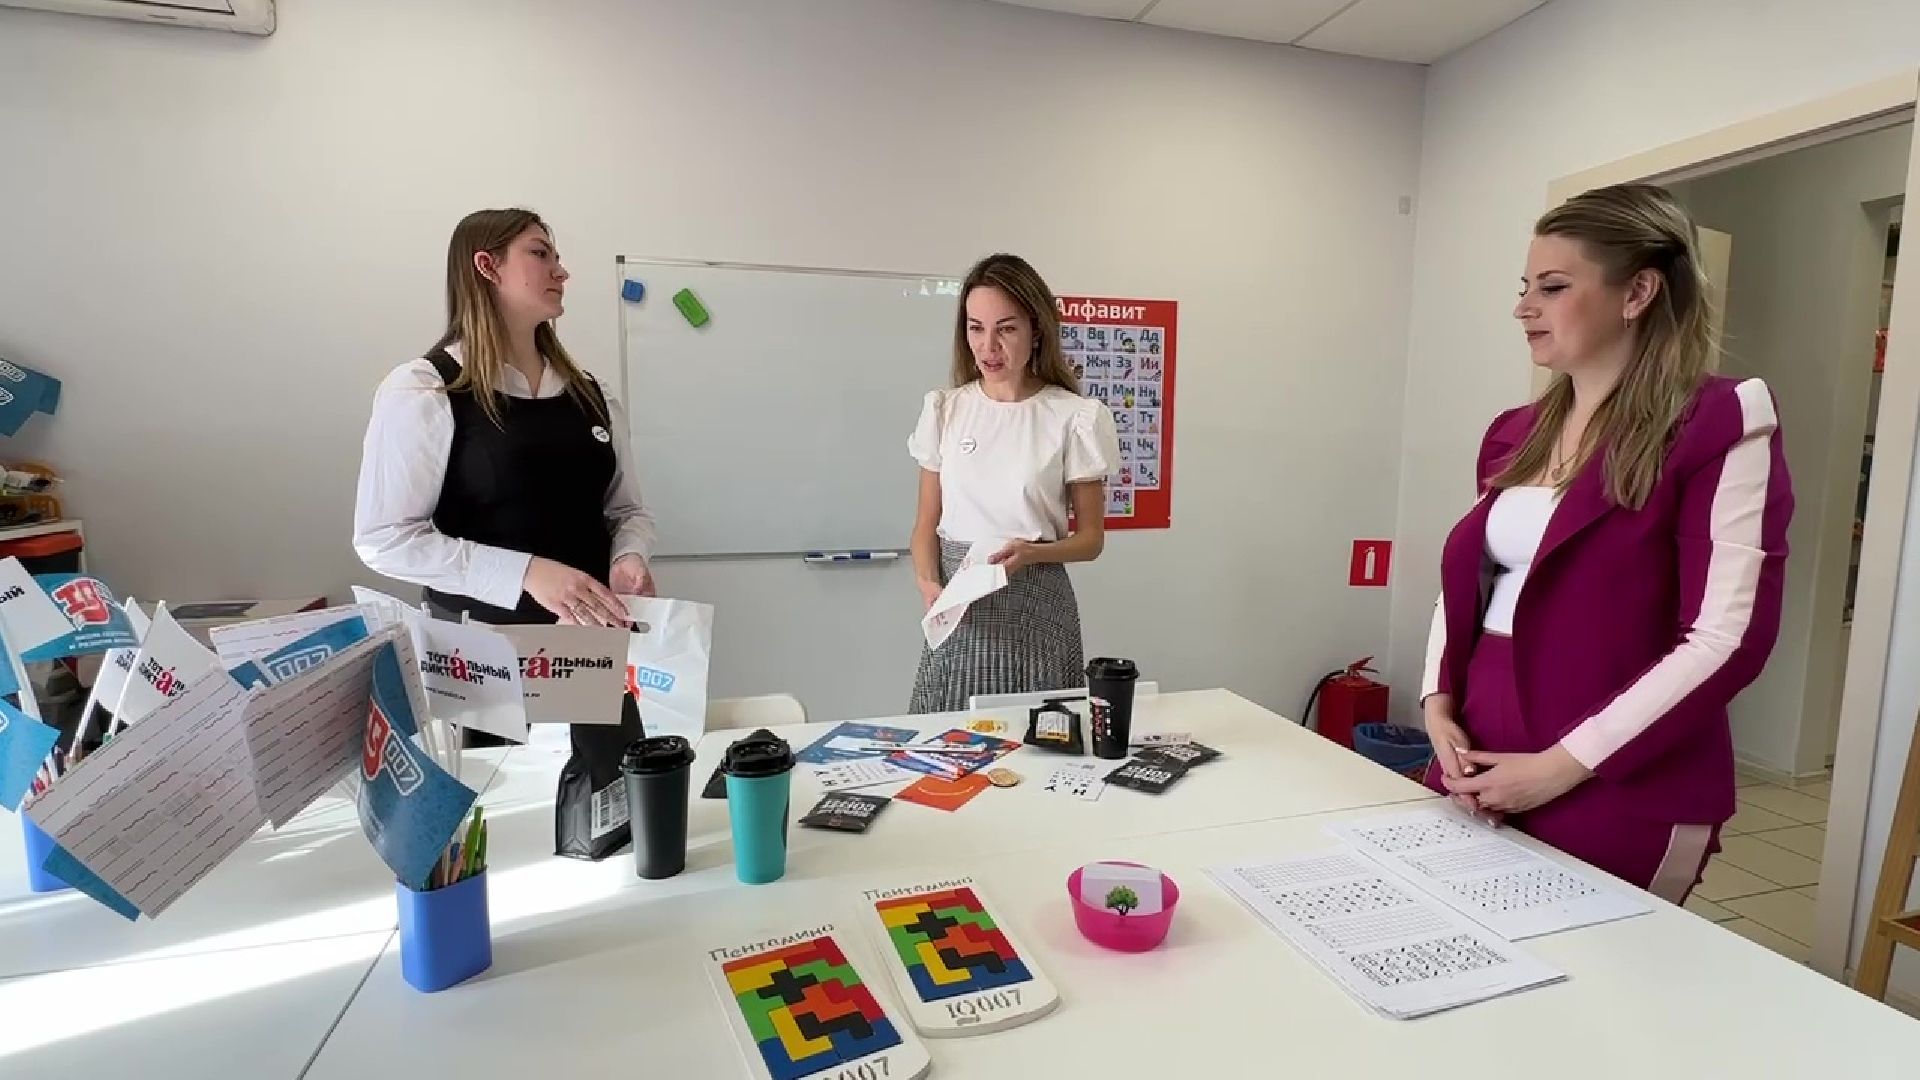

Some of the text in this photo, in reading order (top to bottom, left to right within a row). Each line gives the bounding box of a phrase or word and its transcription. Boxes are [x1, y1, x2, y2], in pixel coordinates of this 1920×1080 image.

[1055, 298, 1147, 322] Алфавит
[1061, 326, 1159, 342] Бб Вв Гг Дд
[1086, 355, 1110, 367] Жж
[1116, 355, 1131, 368] Зз
[1141, 357, 1159, 369] Ии
[1087, 383, 1156, 397] Лл Мм Нн
[1113, 411, 1153, 423] Сс Тт
[1137, 438, 1154, 451] Чч
[1113, 490, 1130, 502] Яя
[640, 669, 673, 688] 007
[387, 740, 418, 782] 007
[863, 876, 973, 900] Пентамино
[708, 923, 835, 961] Пентамино
